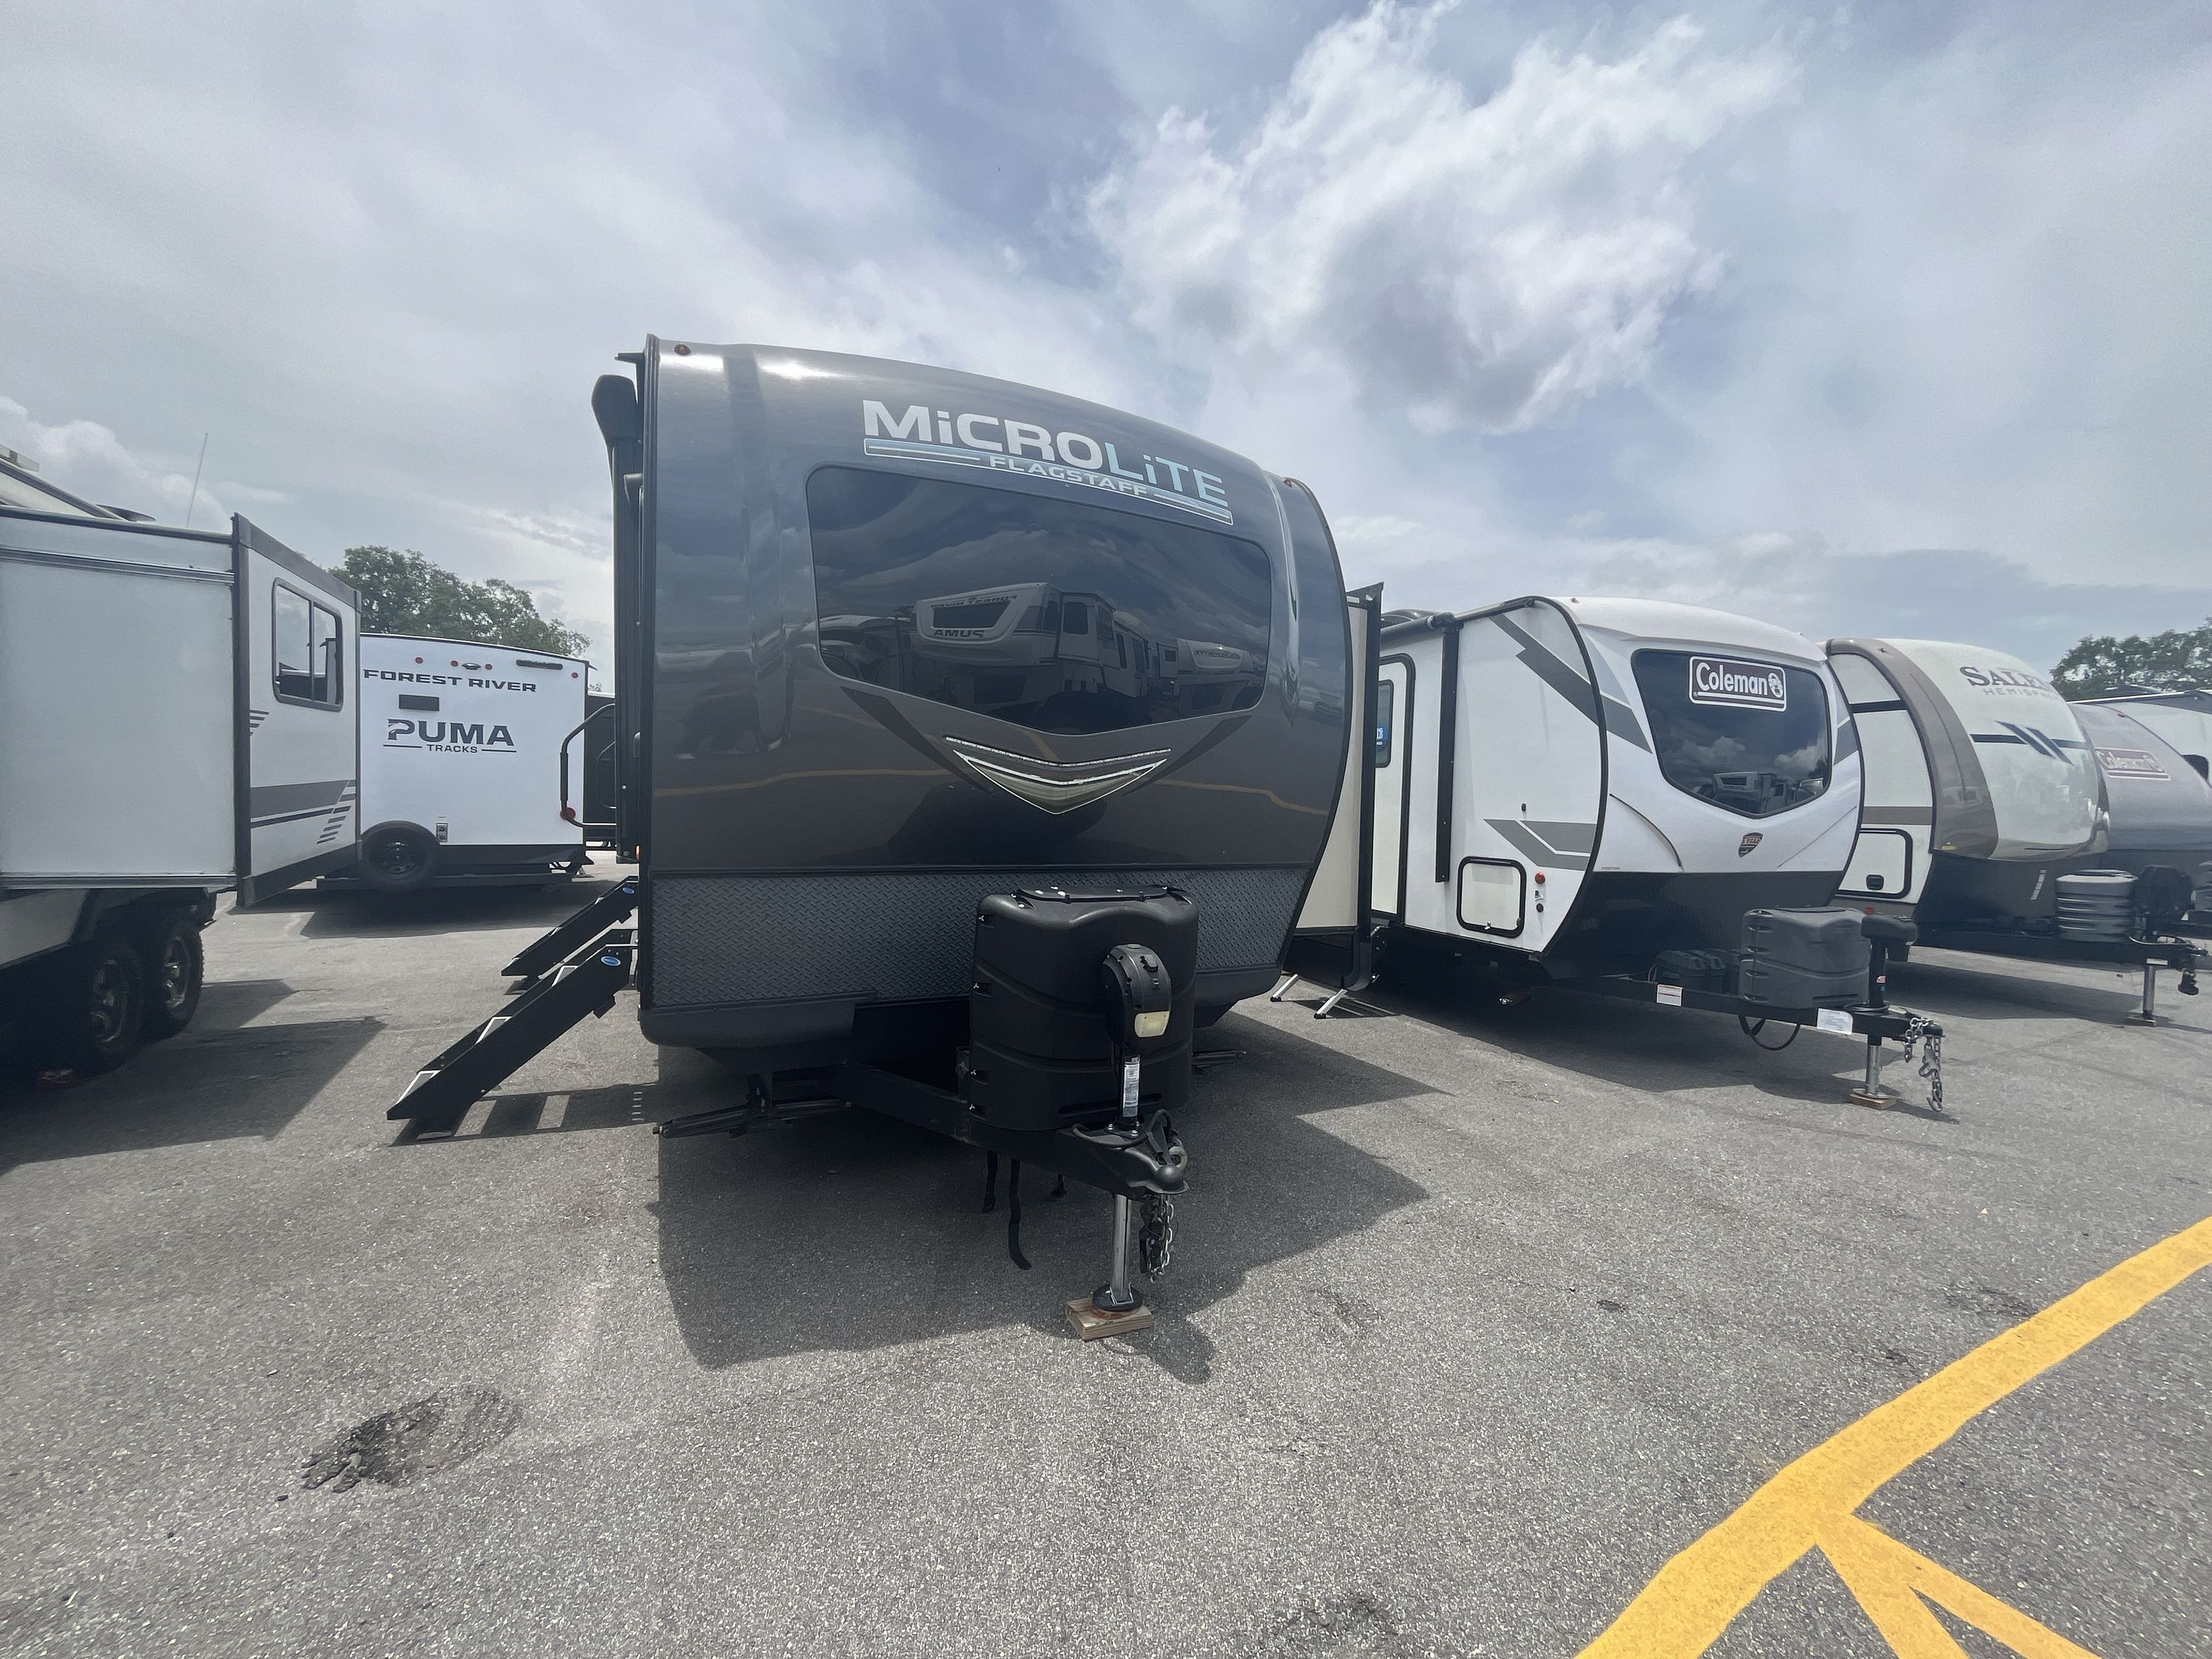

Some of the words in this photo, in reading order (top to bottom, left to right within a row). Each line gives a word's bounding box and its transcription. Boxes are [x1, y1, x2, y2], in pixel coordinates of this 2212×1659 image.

[989, 454, 1148, 496] FLAGSTAFF
[363, 669, 462, 686] FOREST
[468, 678, 536, 692] RIVER
[1696, 662, 1768, 696] Coleman
[387, 718, 515, 746] PUMA
[426, 744, 478, 753] TRACKS
